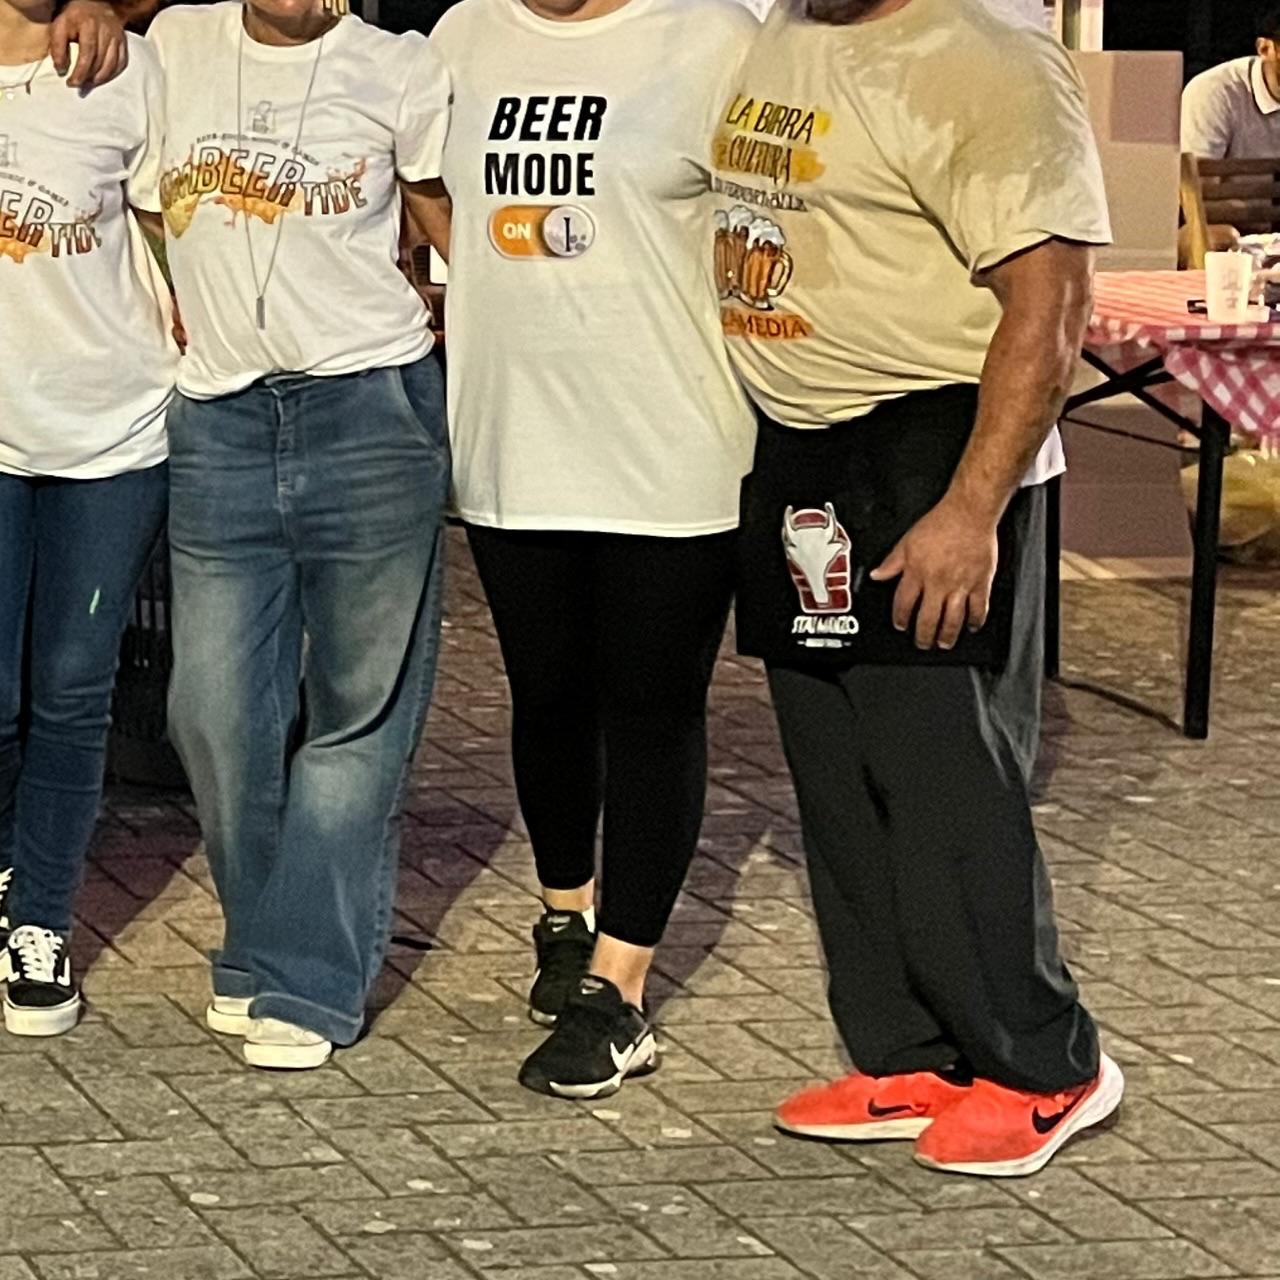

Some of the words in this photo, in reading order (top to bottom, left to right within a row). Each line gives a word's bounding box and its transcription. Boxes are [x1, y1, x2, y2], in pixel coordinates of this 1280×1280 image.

[487, 95, 608, 142] BEER
[484, 152, 596, 197] MODE
[502, 222, 532, 240] ON
